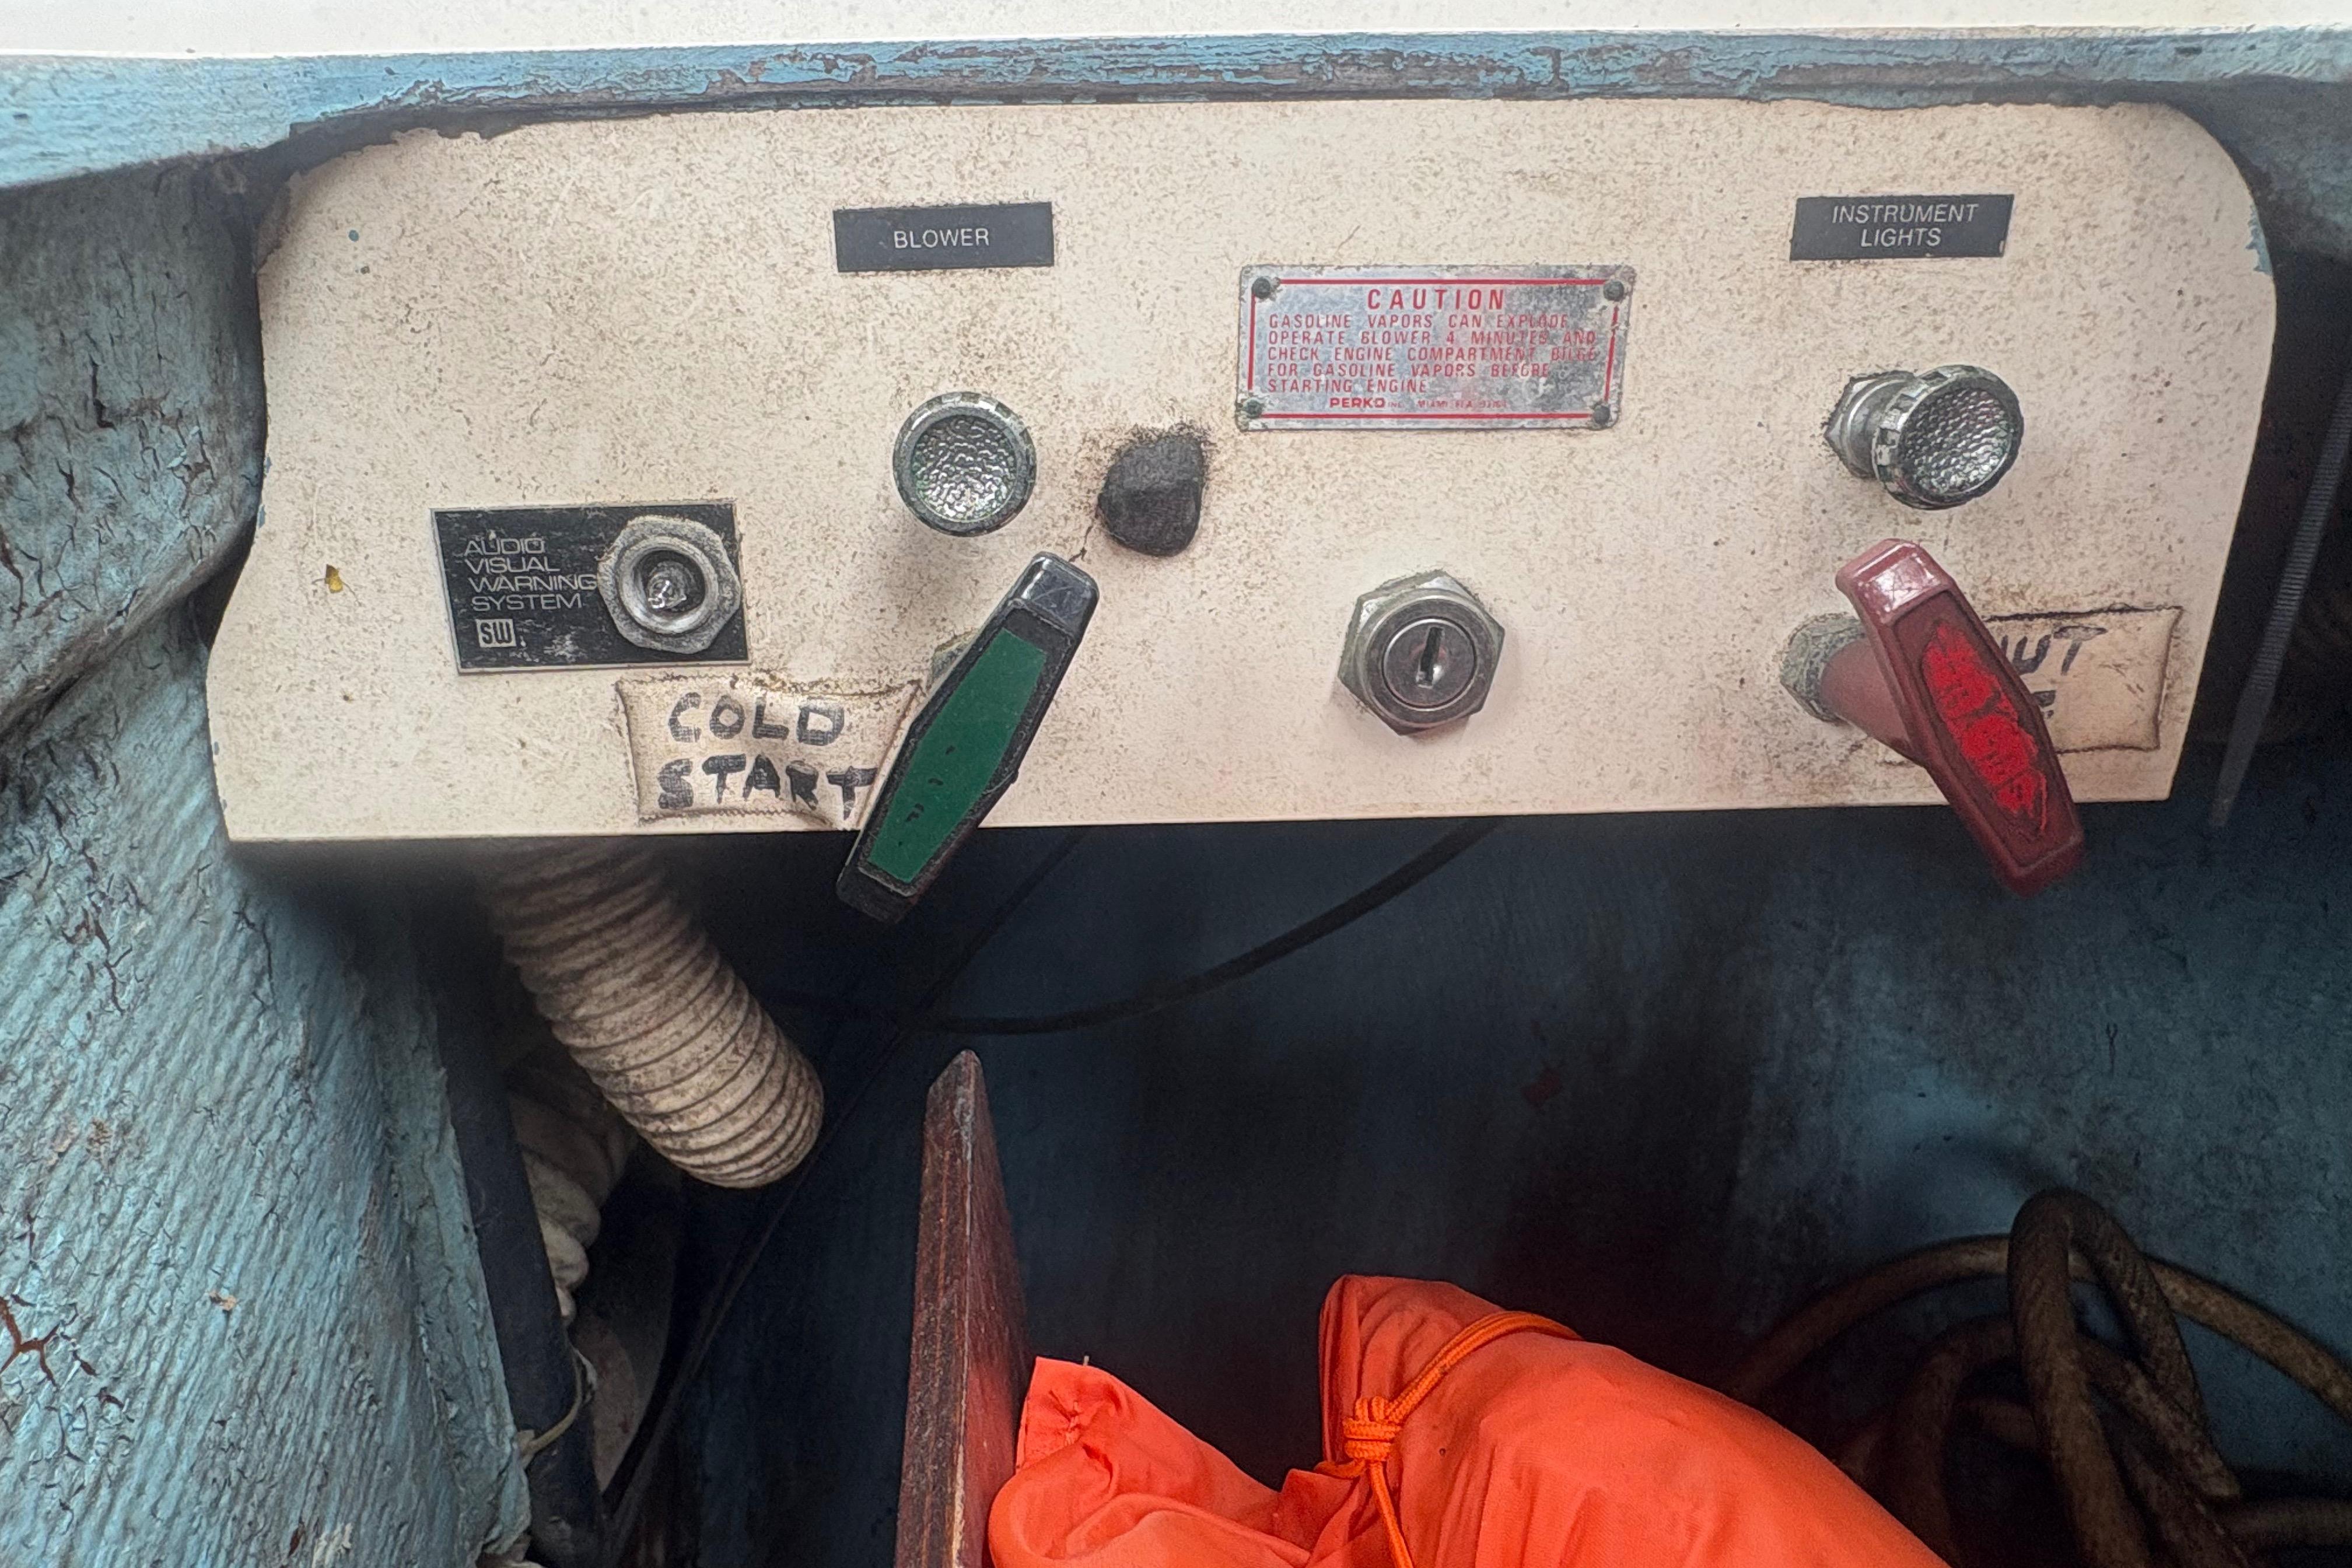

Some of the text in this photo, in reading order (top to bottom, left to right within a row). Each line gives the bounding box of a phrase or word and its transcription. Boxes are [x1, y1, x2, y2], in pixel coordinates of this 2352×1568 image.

[1832, 203, 1979, 224] INSTRUMENT
[893, 228, 990, 249] BLOWER
[1860, 228, 1942, 248] LIGHTS
[1367, 288, 1504, 310] CAUTION
[1269, 314, 1569, 329] GASOLINE VAPORS CAN EXPLODE
[1268, 330, 1597, 345] OPERATE BLOWER 4 MINUTES AND
[1268, 346, 1597, 362] CHECK ENGINE COMPARTMENT BILGE
[1268, 363, 1549, 377] FOR GASOLINE VAPORS BEFORE
[1268, 379, 1427, 393] STARTING ENGINE
[1329, 397, 1385, 408] PERKO
[464, 537, 545, 555] AUDIO
[466, 556, 561, 573] VISUAL
[468, 573, 598, 593] WARNING
[472, 593, 583, 612] SYSTEM
[668, 692, 845, 746] COLD
[657, 753, 877, 821] START
